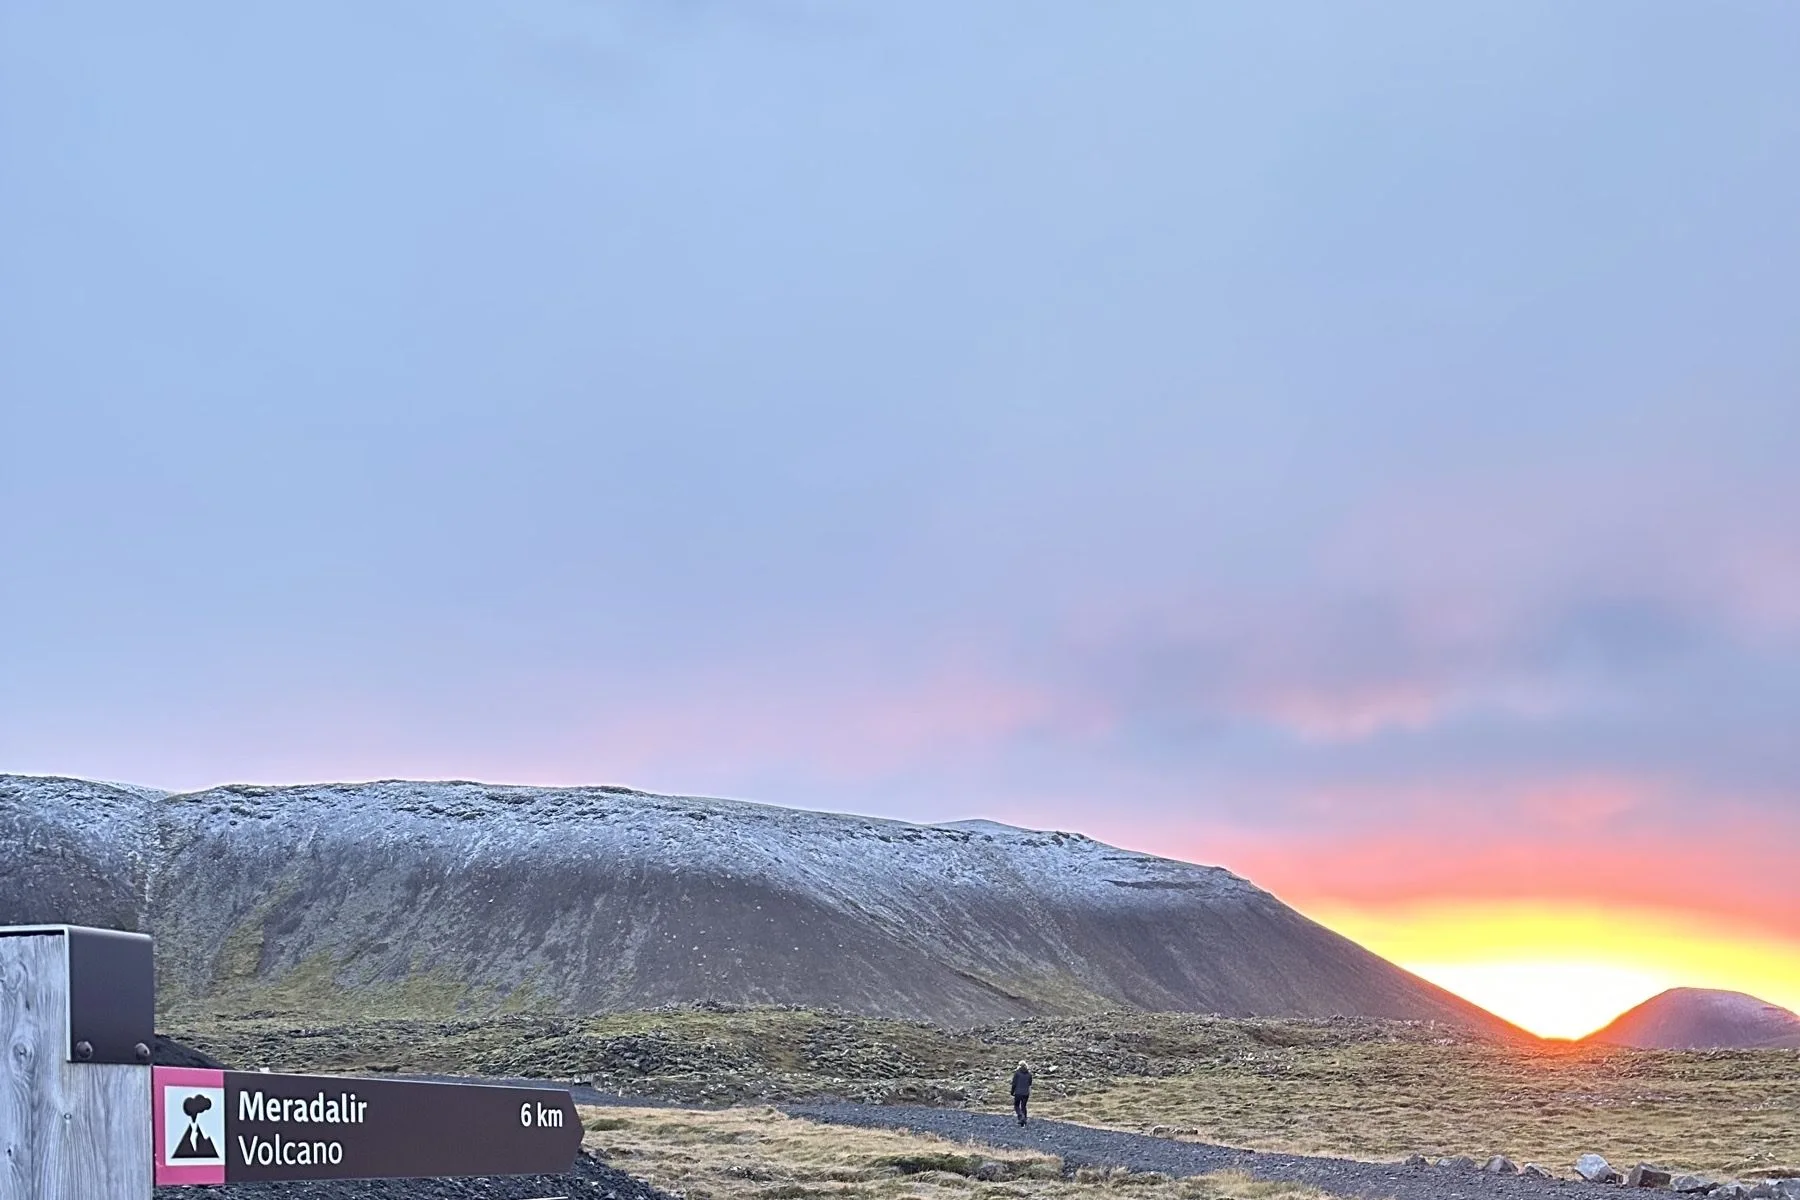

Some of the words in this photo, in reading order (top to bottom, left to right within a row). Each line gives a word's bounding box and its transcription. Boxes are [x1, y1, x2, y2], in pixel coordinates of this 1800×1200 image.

[238, 1090, 369, 1124] Meradalir
[521, 1102, 532, 1127] 6
[537, 1101, 563, 1128] km
[237, 1134, 344, 1167] Volcano
